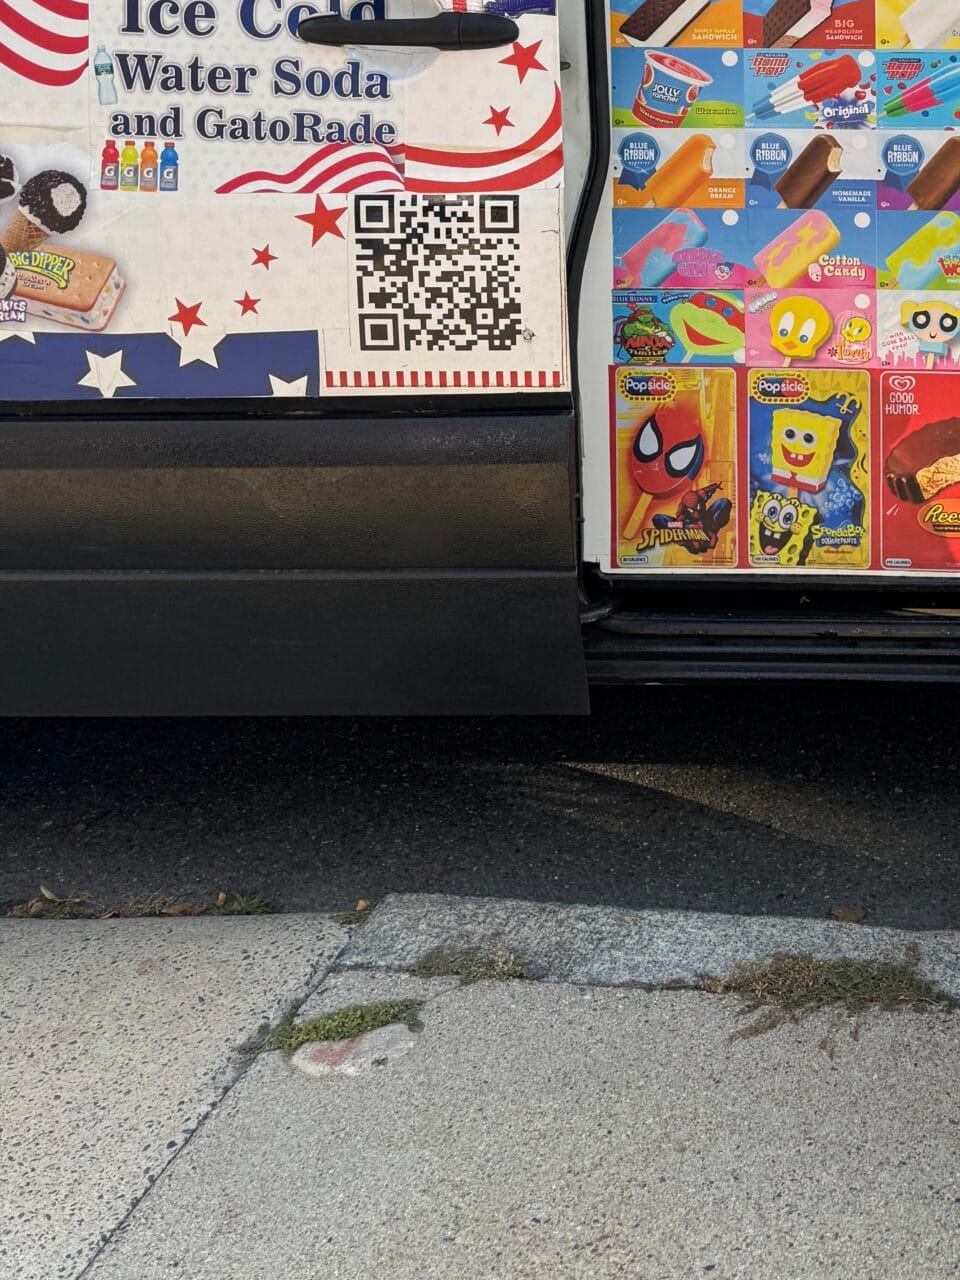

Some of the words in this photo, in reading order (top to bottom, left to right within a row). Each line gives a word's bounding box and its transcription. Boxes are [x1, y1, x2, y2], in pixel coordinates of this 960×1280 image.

[834, 20, 855, 28] BIG
[115, 52, 257, 94] Water
[273, 59, 391, 100] Soda
[652, 83, 680, 98] JOLLY
[651, 92, 679, 103] rancher
[639, 106, 675, 125] Watermelon
[823, 104, 870, 118] Original
[111, 106, 183, 138] and
[196, 108, 396, 145] GatoRade
[893, 144, 913, 152] BLUE
[624, 149, 655, 161] RIBBON
[756, 149, 787, 162] RIBBON
[888, 151, 919, 164] RIBBON
[105, 165, 115, 177] G
[124, 165, 134, 177] G
[143, 167, 153, 178] G
[163, 168, 174, 179] G
[9, 251, 30, 267] BIG
[31, 250, 76, 281] DIPPER
[818, 254, 861, 266] Cotton
[823, 265, 866, 281] Candy
[625, 378, 671, 392] Popsicle
[758, 379, 804, 394] Popsicle
[889, 392, 914, 403] GOOD
[885, 405, 919, 416] HUMOR
